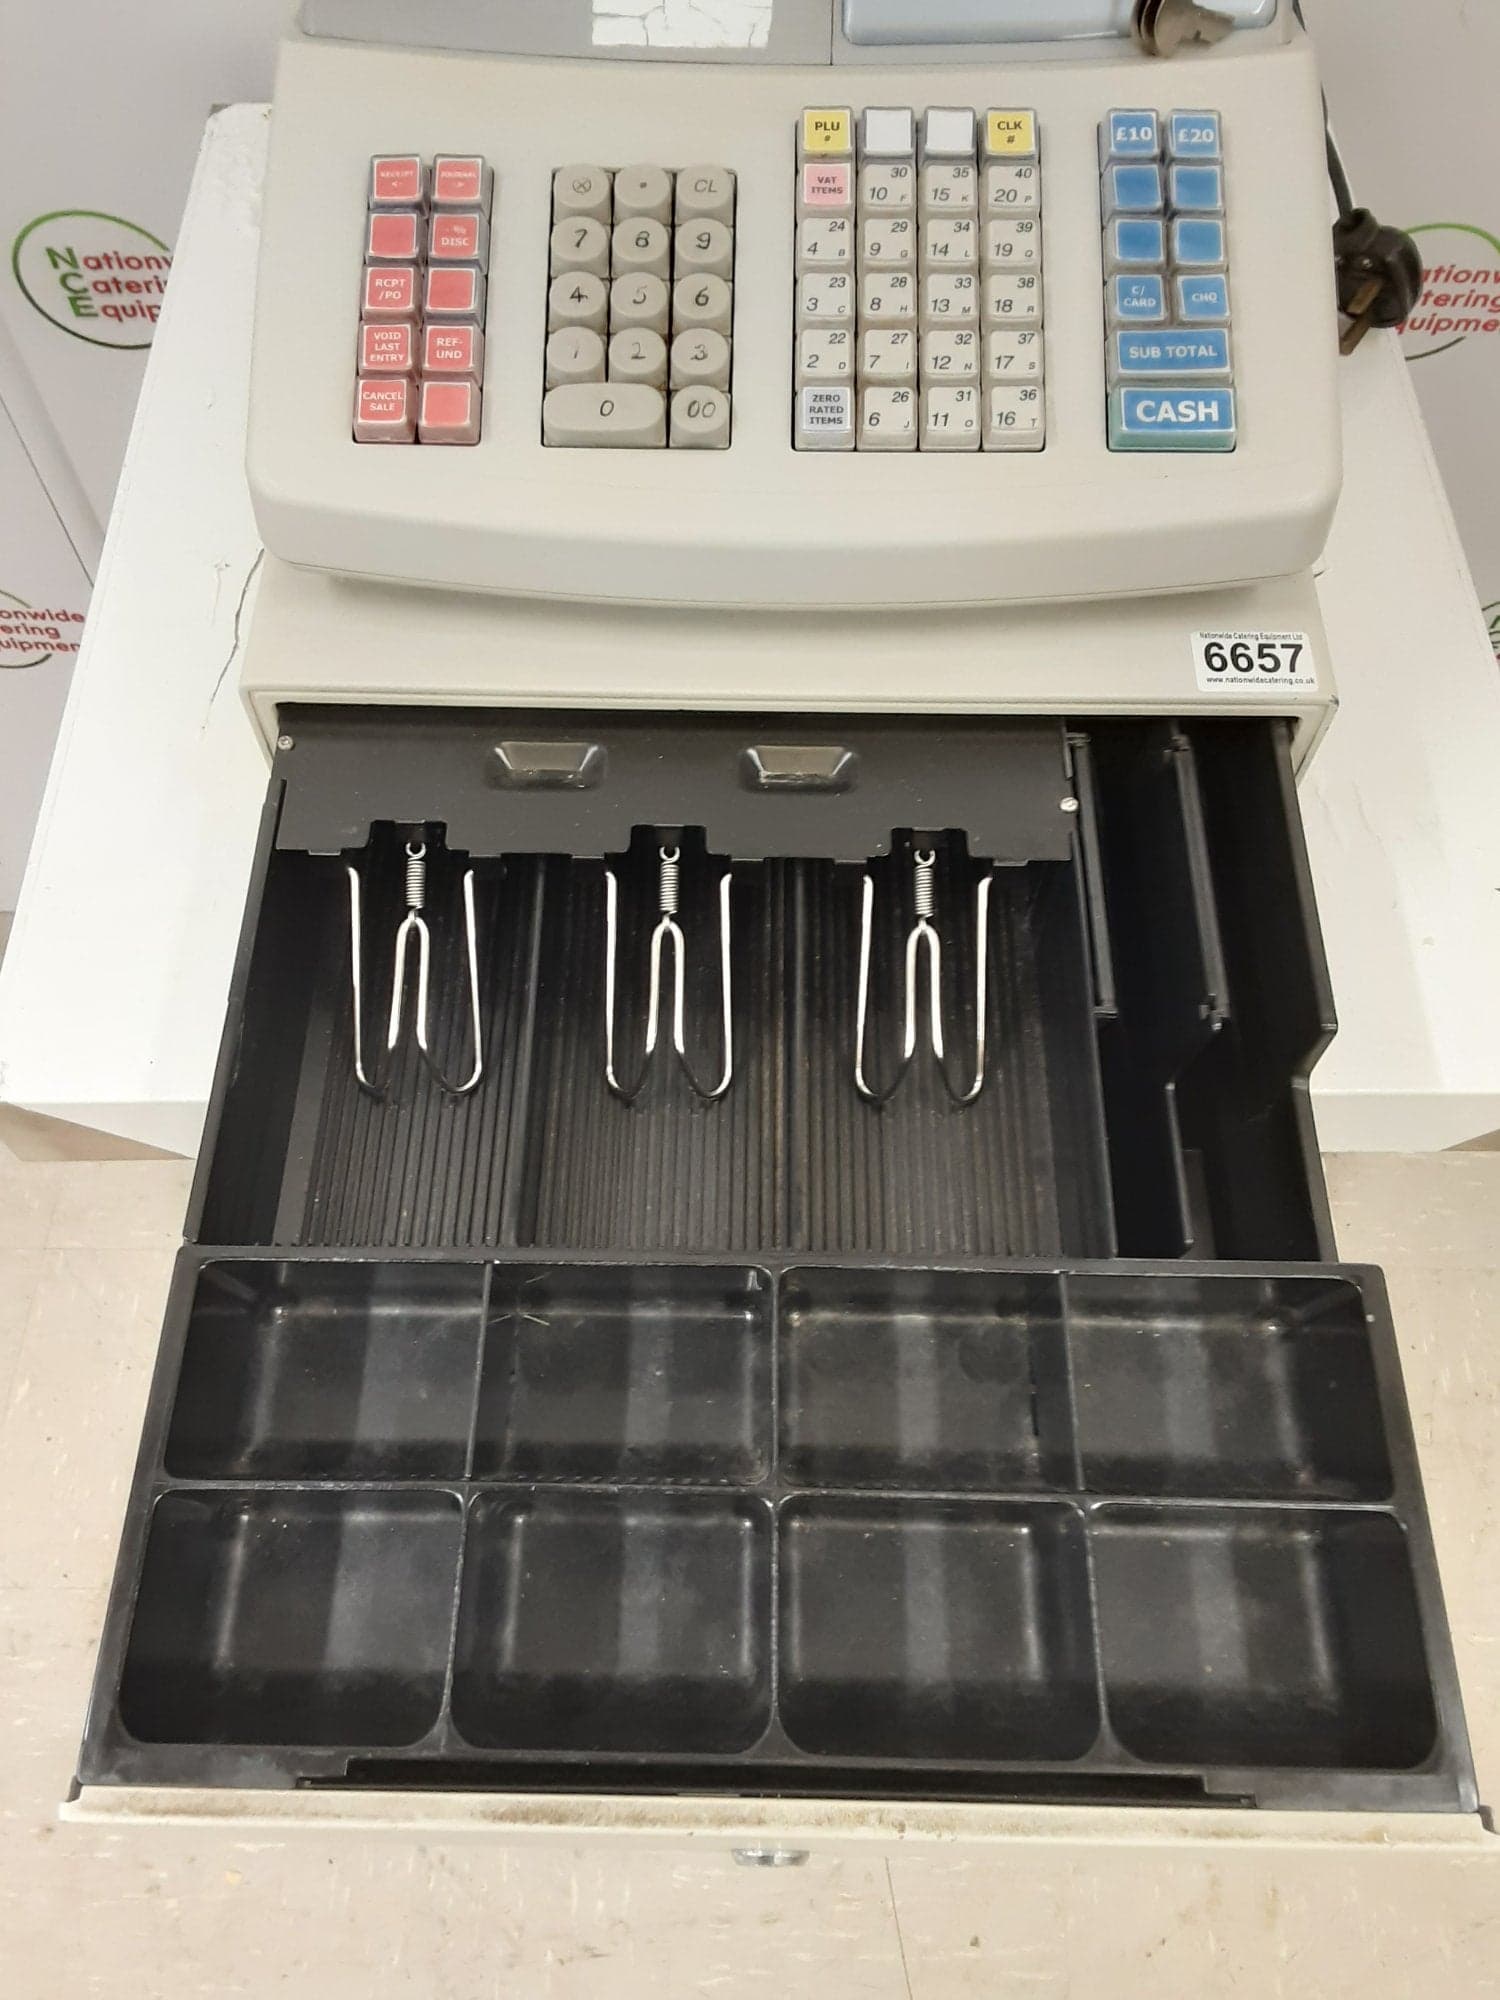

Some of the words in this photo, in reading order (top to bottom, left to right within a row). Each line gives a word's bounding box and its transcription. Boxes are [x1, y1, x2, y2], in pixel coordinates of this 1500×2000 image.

[815, 122, 840, 131] PLU
[997, 121, 1022, 130] CLK
[1116, 127, 1151, 141] £10
[1178, 129, 1214, 143] £20
[891, 168, 907, 178] 30
[953, 168, 969, 178] 35
[1015, 168, 1032, 178] 40
[818, 176, 836, 184] VAT
[694, 179, 718, 193] CL
[812, 186, 843, 194] ITEMS
[869, 188, 887, 200] 10
[931, 188, 950, 201] 15
[994, 189, 1017, 202] 20
[829, 222, 845, 232] 24
[891, 222, 907, 232] 29
[954, 222, 970, 232] 34
[1016, 222, 1033, 232] 39
[441, 237, 468, 246] DISC
[575, 229, 587, 248] 7
[635, 231, 650, 248] 8
[696, 232, 711, 249] 9
[808, 242, 818, 255] 4
[870, 243, 881, 255] 9
[931, 243, 949, 256] 14
[994, 244, 1012, 256] 19
[376, 279, 405, 288] RCPT
[829, 278, 846, 288] 23
[891, 277, 907, 287] 28
[955, 278, 972, 288] 33
[1017, 278, 1035, 288] 38
[379, 290, 401, 300] /PO
[570, 287, 588, 303] 4
[633, 286, 647, 304] 5
[695, 287, 709, 305] 6
[1131, 285, 1145, 296] C/
[1124, 298, 1156, 308] CARD
[1192, 292, 1218, 303] CHQ
[807, 298, 818, 310] 3
[838, 305, 845, 313] C
[870, 298, 881, 310] 8
[931, 299, 950, 312] 13
[962, 306, 971, 314] M
[994, 299, 1012, 312] 18
[374, 332, 401, 340] VOID
[829, 334, 846, 344] 22
[891, 334, 908, 344] 27
[955, 334, 972, 344] 32
[1018, 334, 1035, 344] 37
[375, 342, 400, 351] LAST
[631, 343, 646, 360] 2
[1129, 346, 1161, 358] SUB
[1166, 345, 1217, 358] TOTAL
[370, 354, 403, 362] ENTRY
[436, 350, 462, 360] UND
[691, 345, 708, 360] 3
[807, 355, 819, 368] 2
[838, 362, 846, 370] D
[870, 355, 880, 368] 7
[931, 356, 951, 369] 12
[994, 356, 1014, 369] 17
[363, 392, 402, 400] CANCEL
[812, 394, 840, 402] ZERO
[892, 391, 910, 402] 26
[956, 391, 972, 401] 31
[1020, 390, 1037, 401] 36
[370, 402, 394, 412] SALE
[600, 400, 614, 416] 0
[687, 400, 716, 418] 00
[809, 406, 843, 414] RATED
[1136, 401, 1219, 422] CASH
[810, 417, 843, 425] ITEMS
[869, 413, 880, 426] 6
[931, 414, 949, 427] 11
[996, 412, 1015, 425] 16
[1031, 419, 1037, 427] T
[1233, 632, 1259, 640] Catering
[1204, 642, 1303, 673] 6657
